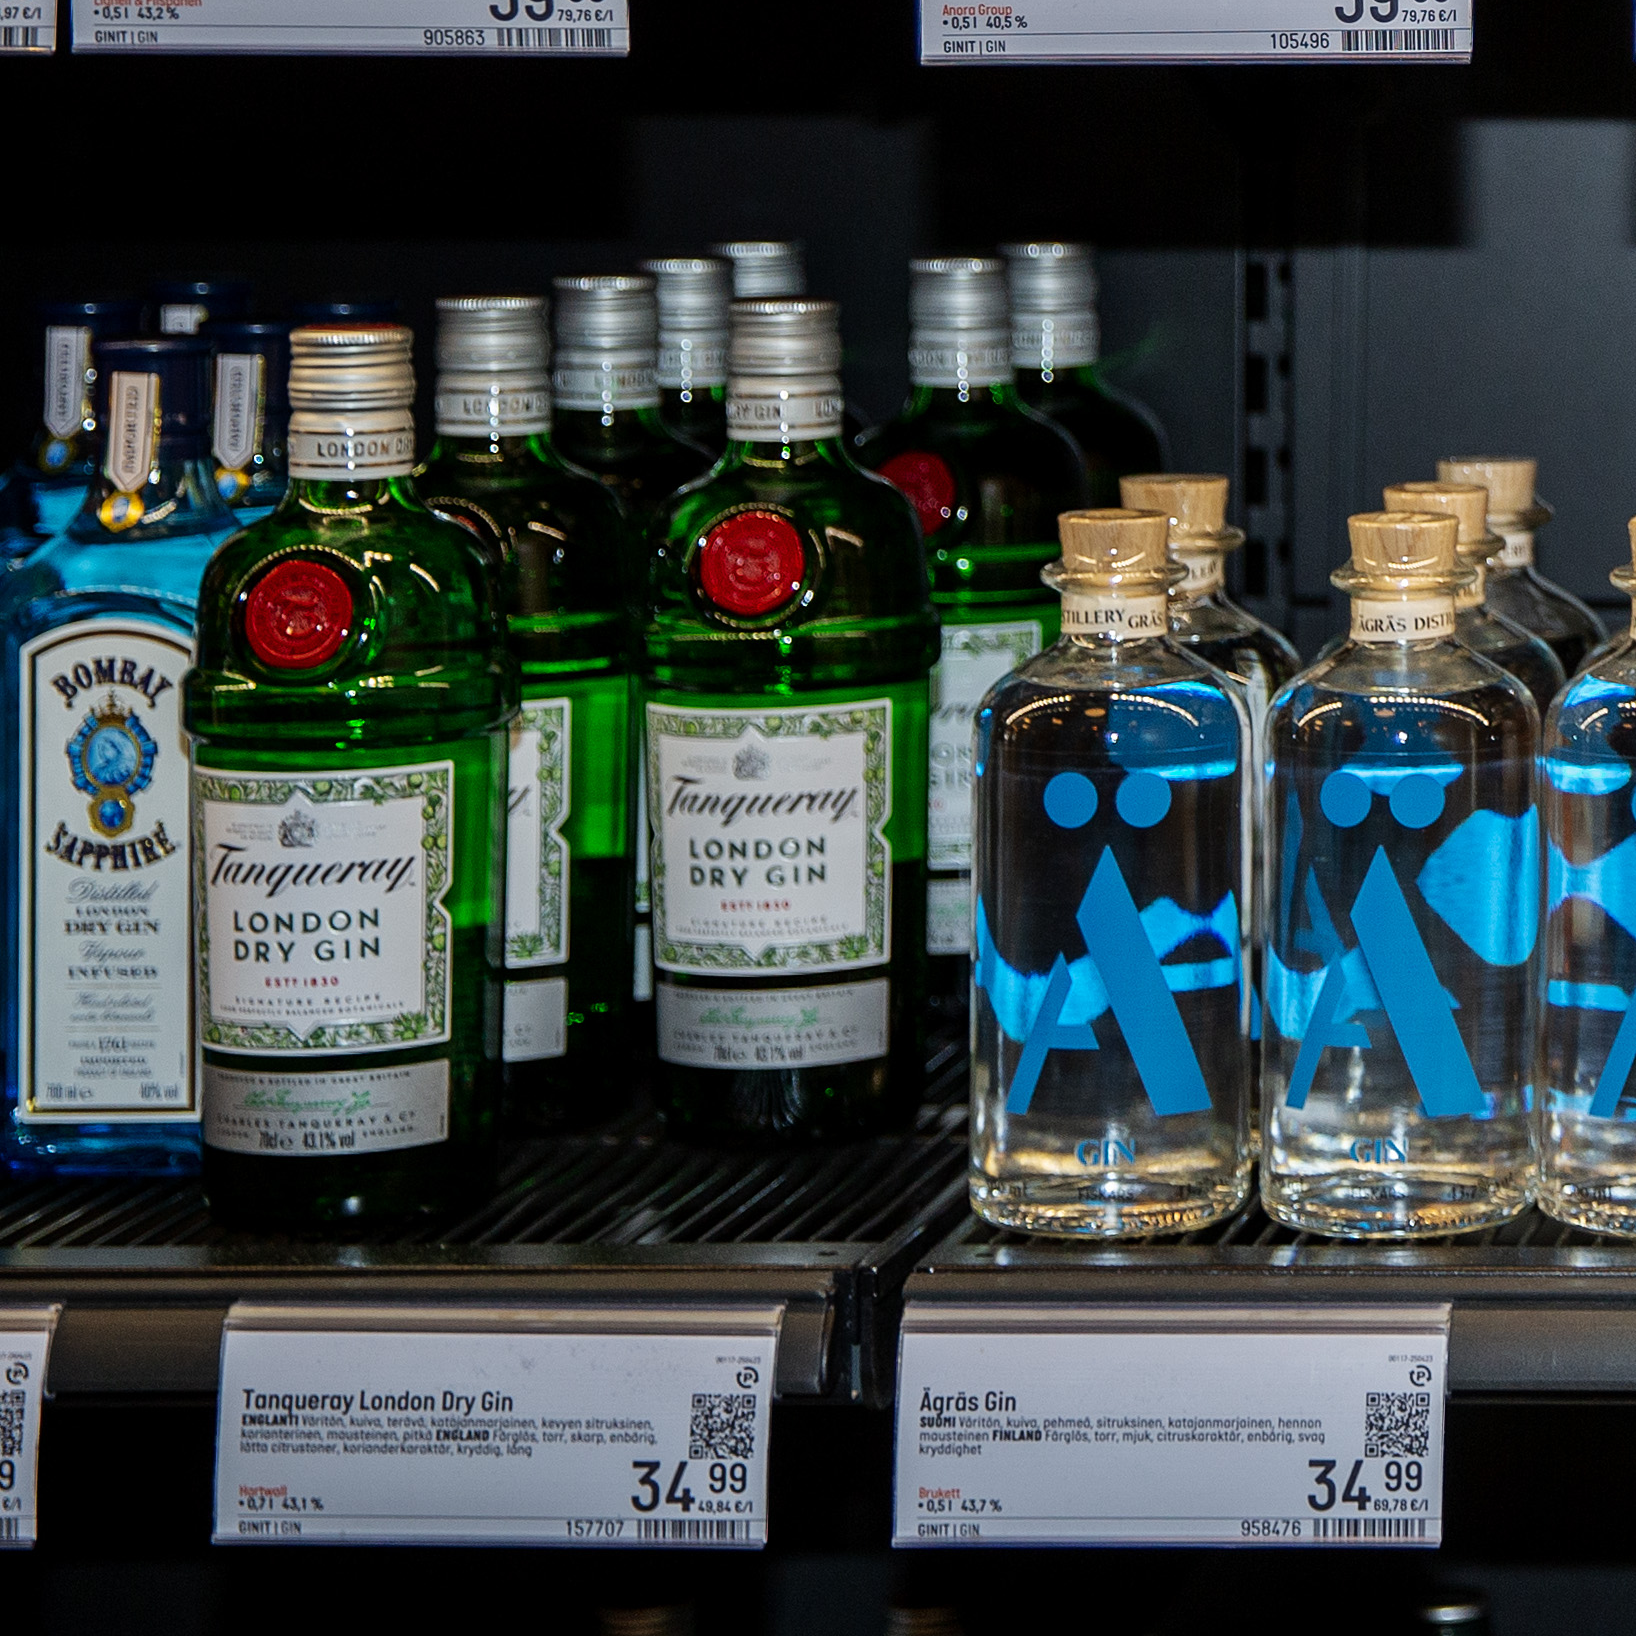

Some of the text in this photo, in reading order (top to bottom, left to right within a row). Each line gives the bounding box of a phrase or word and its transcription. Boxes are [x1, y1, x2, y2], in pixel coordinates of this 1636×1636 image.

[942, 4, 1012, 15] Anora Group
[1270, 32, 1329, 49] 105496
[51, 657, 174, 711] BOMBAY
[45, 820, 177, 873] SAPPHIRE
[209, 843, 417, 897] Tanqueray
[234, 909, 380, 934] LONDON
[234, 936, 381, 963] DRY GIN
[242, 1389, 513, 1417] Tanqueray London Dry Gin
[920, 1387, 1016, 1415] Ägräs Gin
[631, 1460, 747, 1512] 34 99
[1307, 1459, 1422, 1511] 34 99
[1241, 1519, 1301, 1537] 958476
